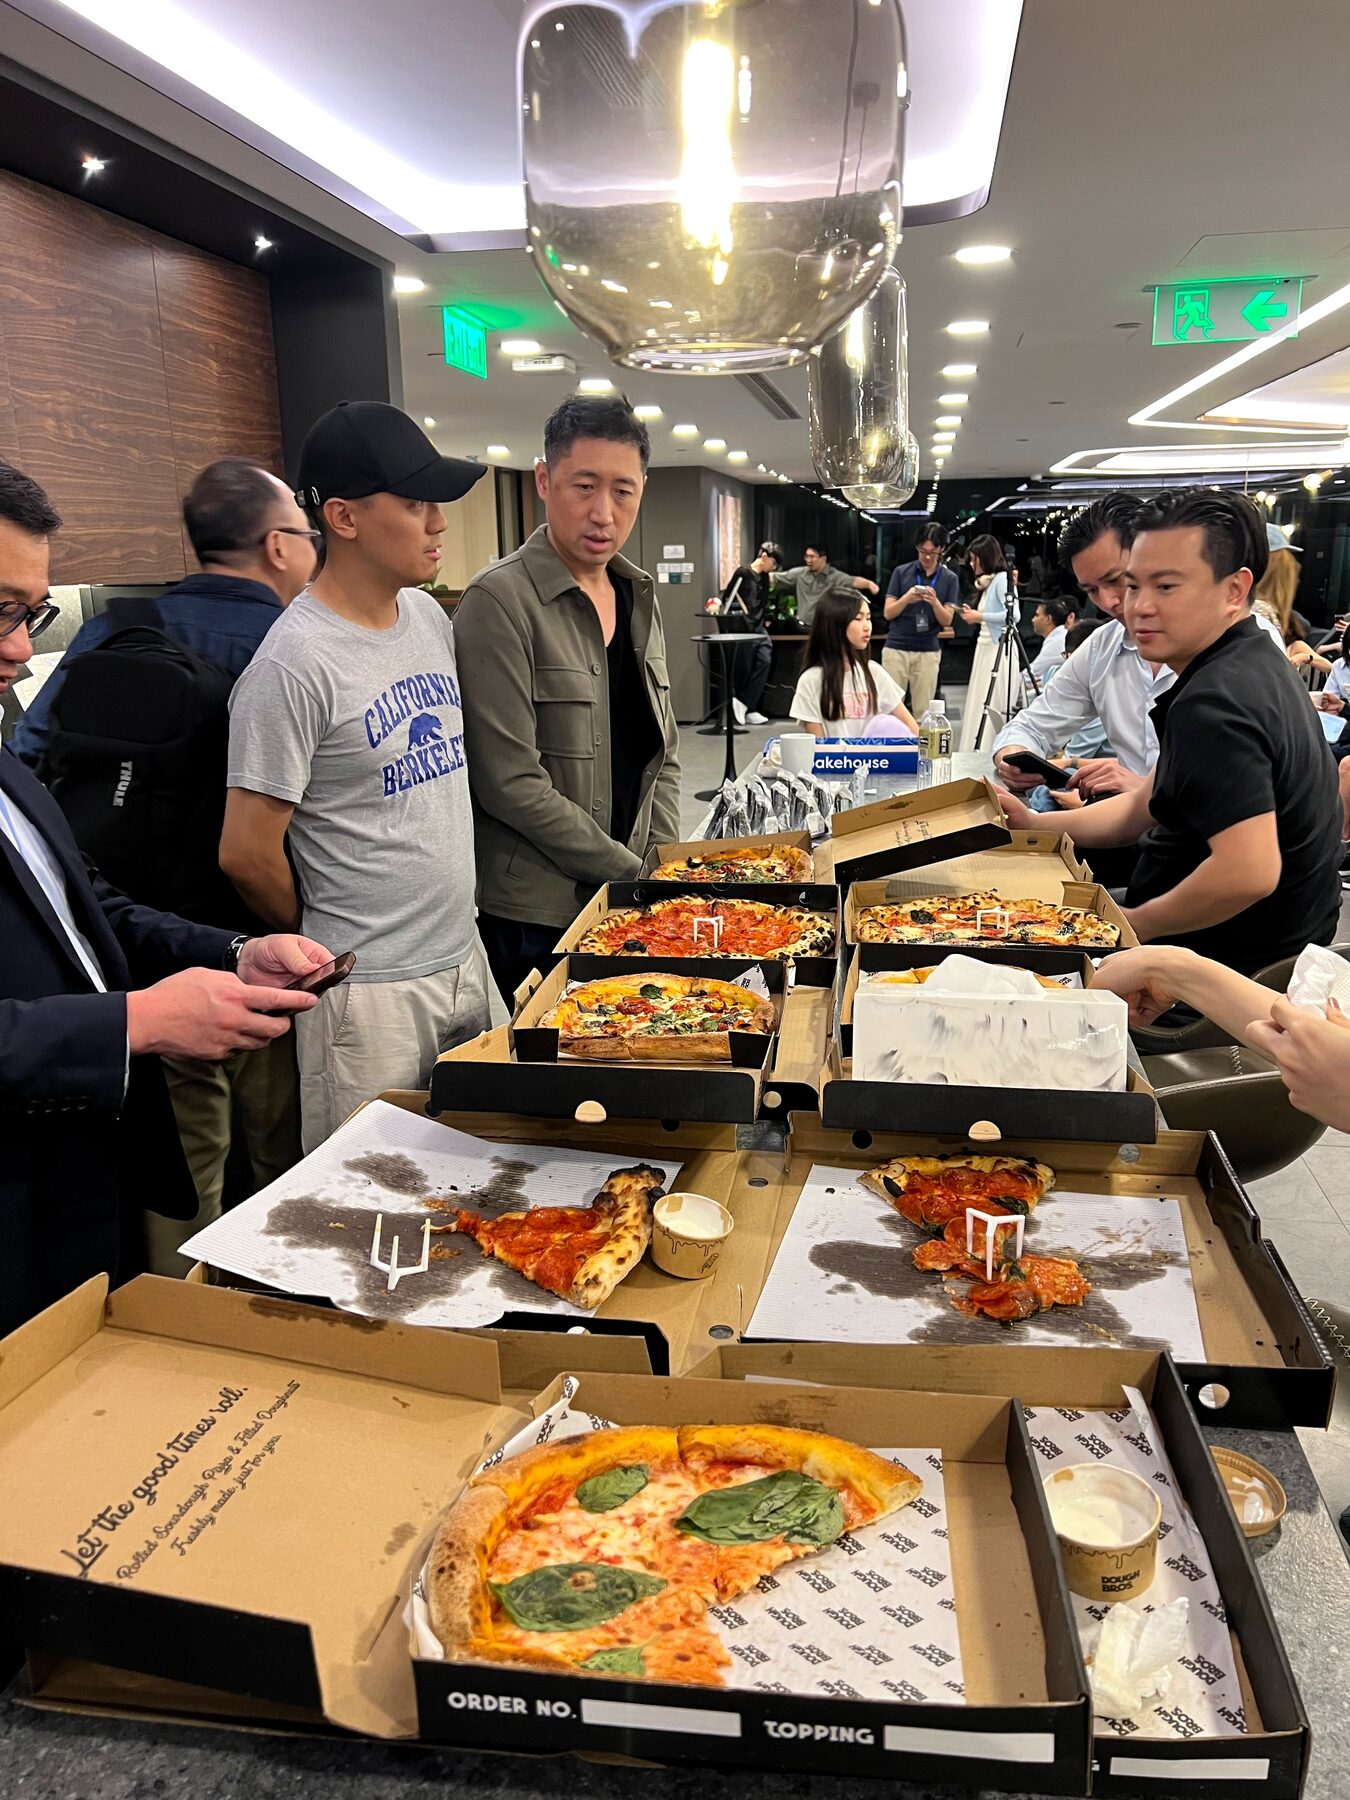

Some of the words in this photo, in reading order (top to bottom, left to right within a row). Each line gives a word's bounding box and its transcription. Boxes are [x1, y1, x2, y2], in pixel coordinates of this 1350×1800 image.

[382, 735, 465, 797] BERKELE
[811, 755, 889, 769] akehouse
[256, 1380, 301, 1421] Doughnuts
[234, 1420, 264, 1447] Filled
[1040, 1435, 1064, 1456] BROS
[1074, 1433, 1106, 1460] DOUGH
[1088, 1433, 1113, 1456] BROS
[227, 1445, 242, 1456] &
[202, 1455, 234, 1480] Pizza
[61, 1526, 109, 1580] Let
[92, 1500, 135, 1532] the
[132, 1453, 180, 1507] good
[166, 1416, 216, 1453] times
[209, 1386, 249, 1414] roll.
[153, 1482, 209, 1540] Sourdough
[170, 1513, 217, 1556] Freshly
[233, 1459, 254, 1491] just
[252, 1452, 266, 1467] for
[908, 1501, 934, 1518] DOUG
[116, 1540, 159, 1579] Rolled
[833, 1538, 857, 1556] DOUG
[1101, 1570, 1141, 1584] DOUGH
[1164, 1557, 1200, 1582] DOUGH
[1178, 1553, 1208, 1579] BROS
[1101, 1581, 1134, 1592] BROS
[1177, 1656, 1217, 1686] DOUGH
[1194, 1653, 1227, 1680] BROS
[448, 1691, 528, 1714] ORDER
[536, 1699, 577, 1719] NO.
[763, 1720, 875, 1745] TOPPING
[1171, 1706, 1205, 1734] BROS
[1216, 1706, 1249, 1734] OUGH
